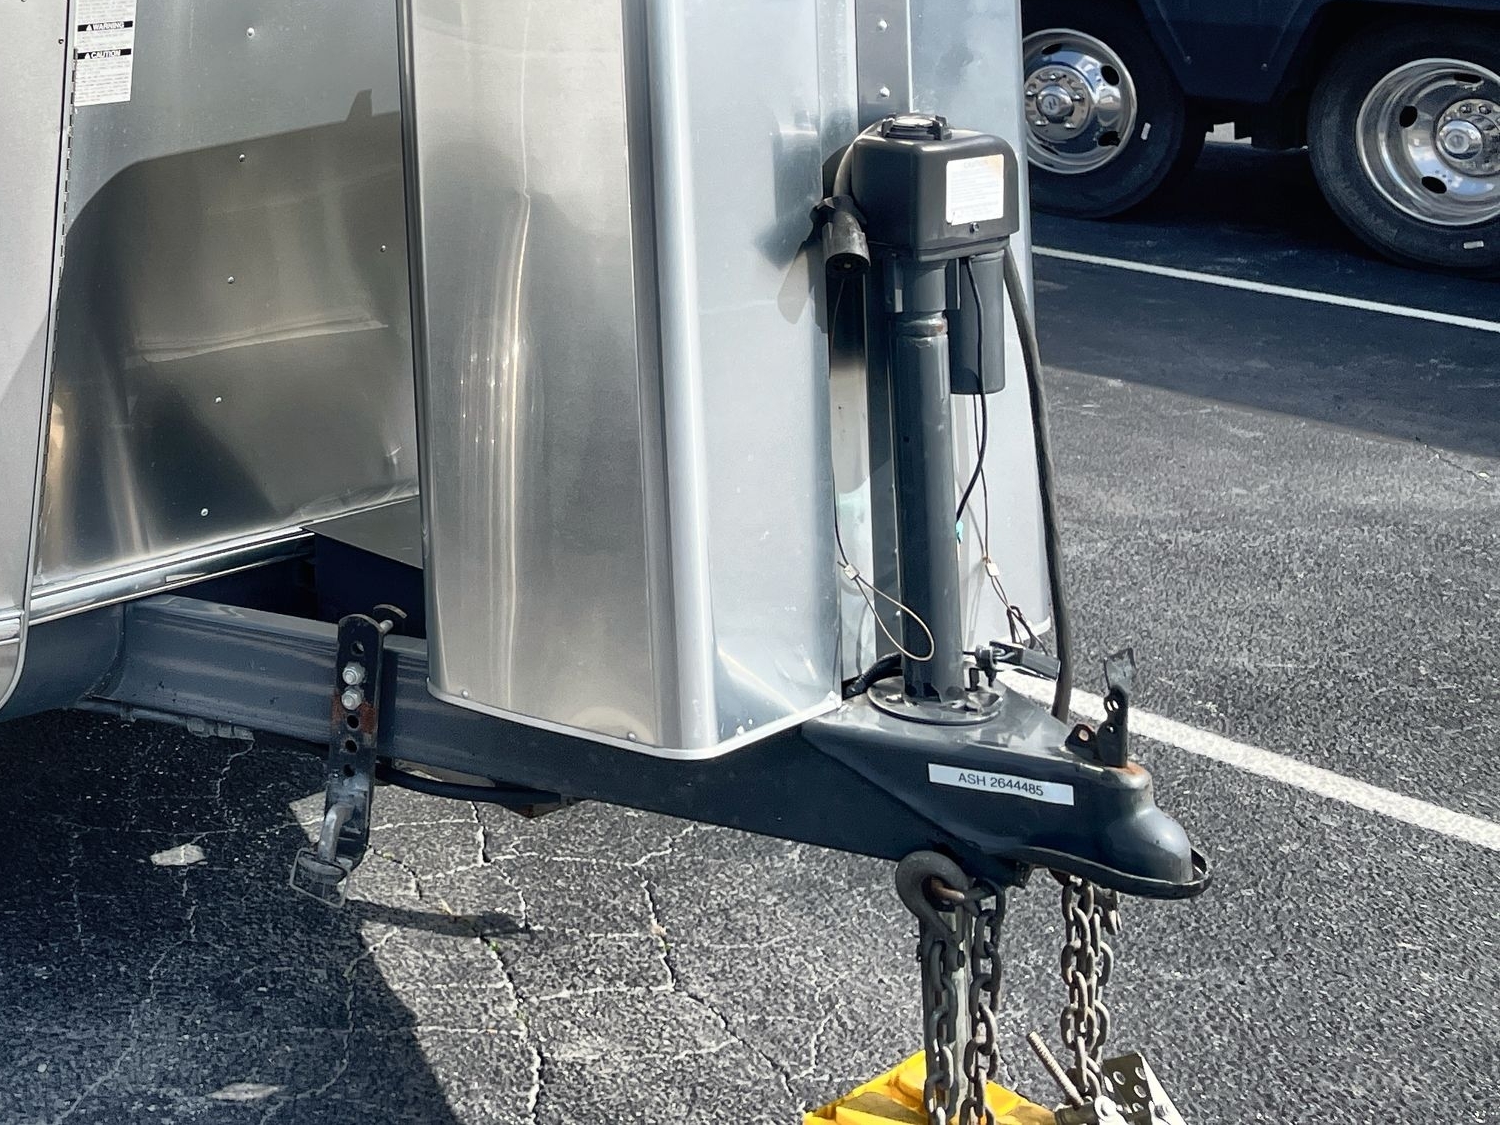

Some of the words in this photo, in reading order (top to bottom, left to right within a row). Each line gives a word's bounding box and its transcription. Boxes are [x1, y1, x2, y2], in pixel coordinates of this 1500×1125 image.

[92, 21, 124, 31] WARNING
[90, 49, 121, 59] CAUTION
[958, 772, 986, 786] ASH
[990, 777, 1044, 796] 2644485
